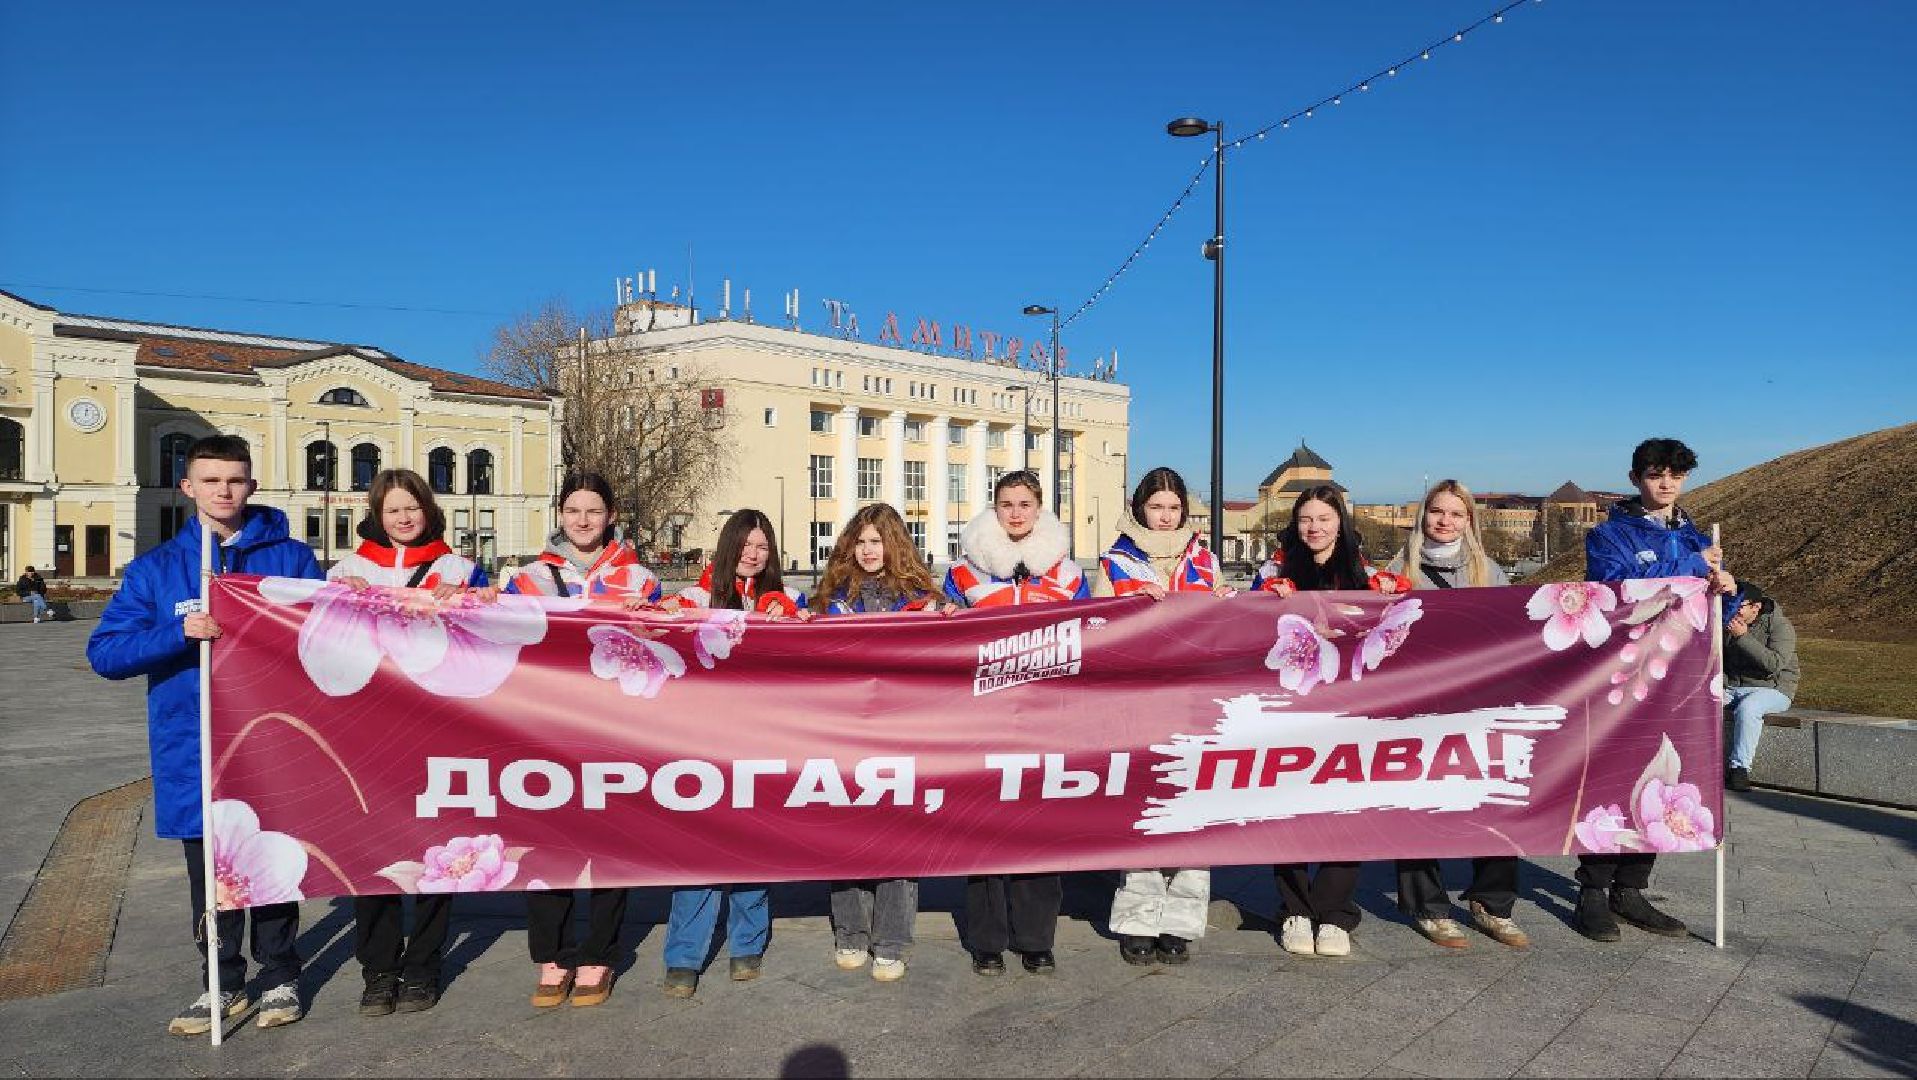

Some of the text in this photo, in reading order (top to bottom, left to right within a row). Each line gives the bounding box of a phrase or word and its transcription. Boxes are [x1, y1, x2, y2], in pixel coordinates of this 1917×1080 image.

[416, 731, 1505, 818] ДОРОГАЯ, ТЫ ПРАВА!
